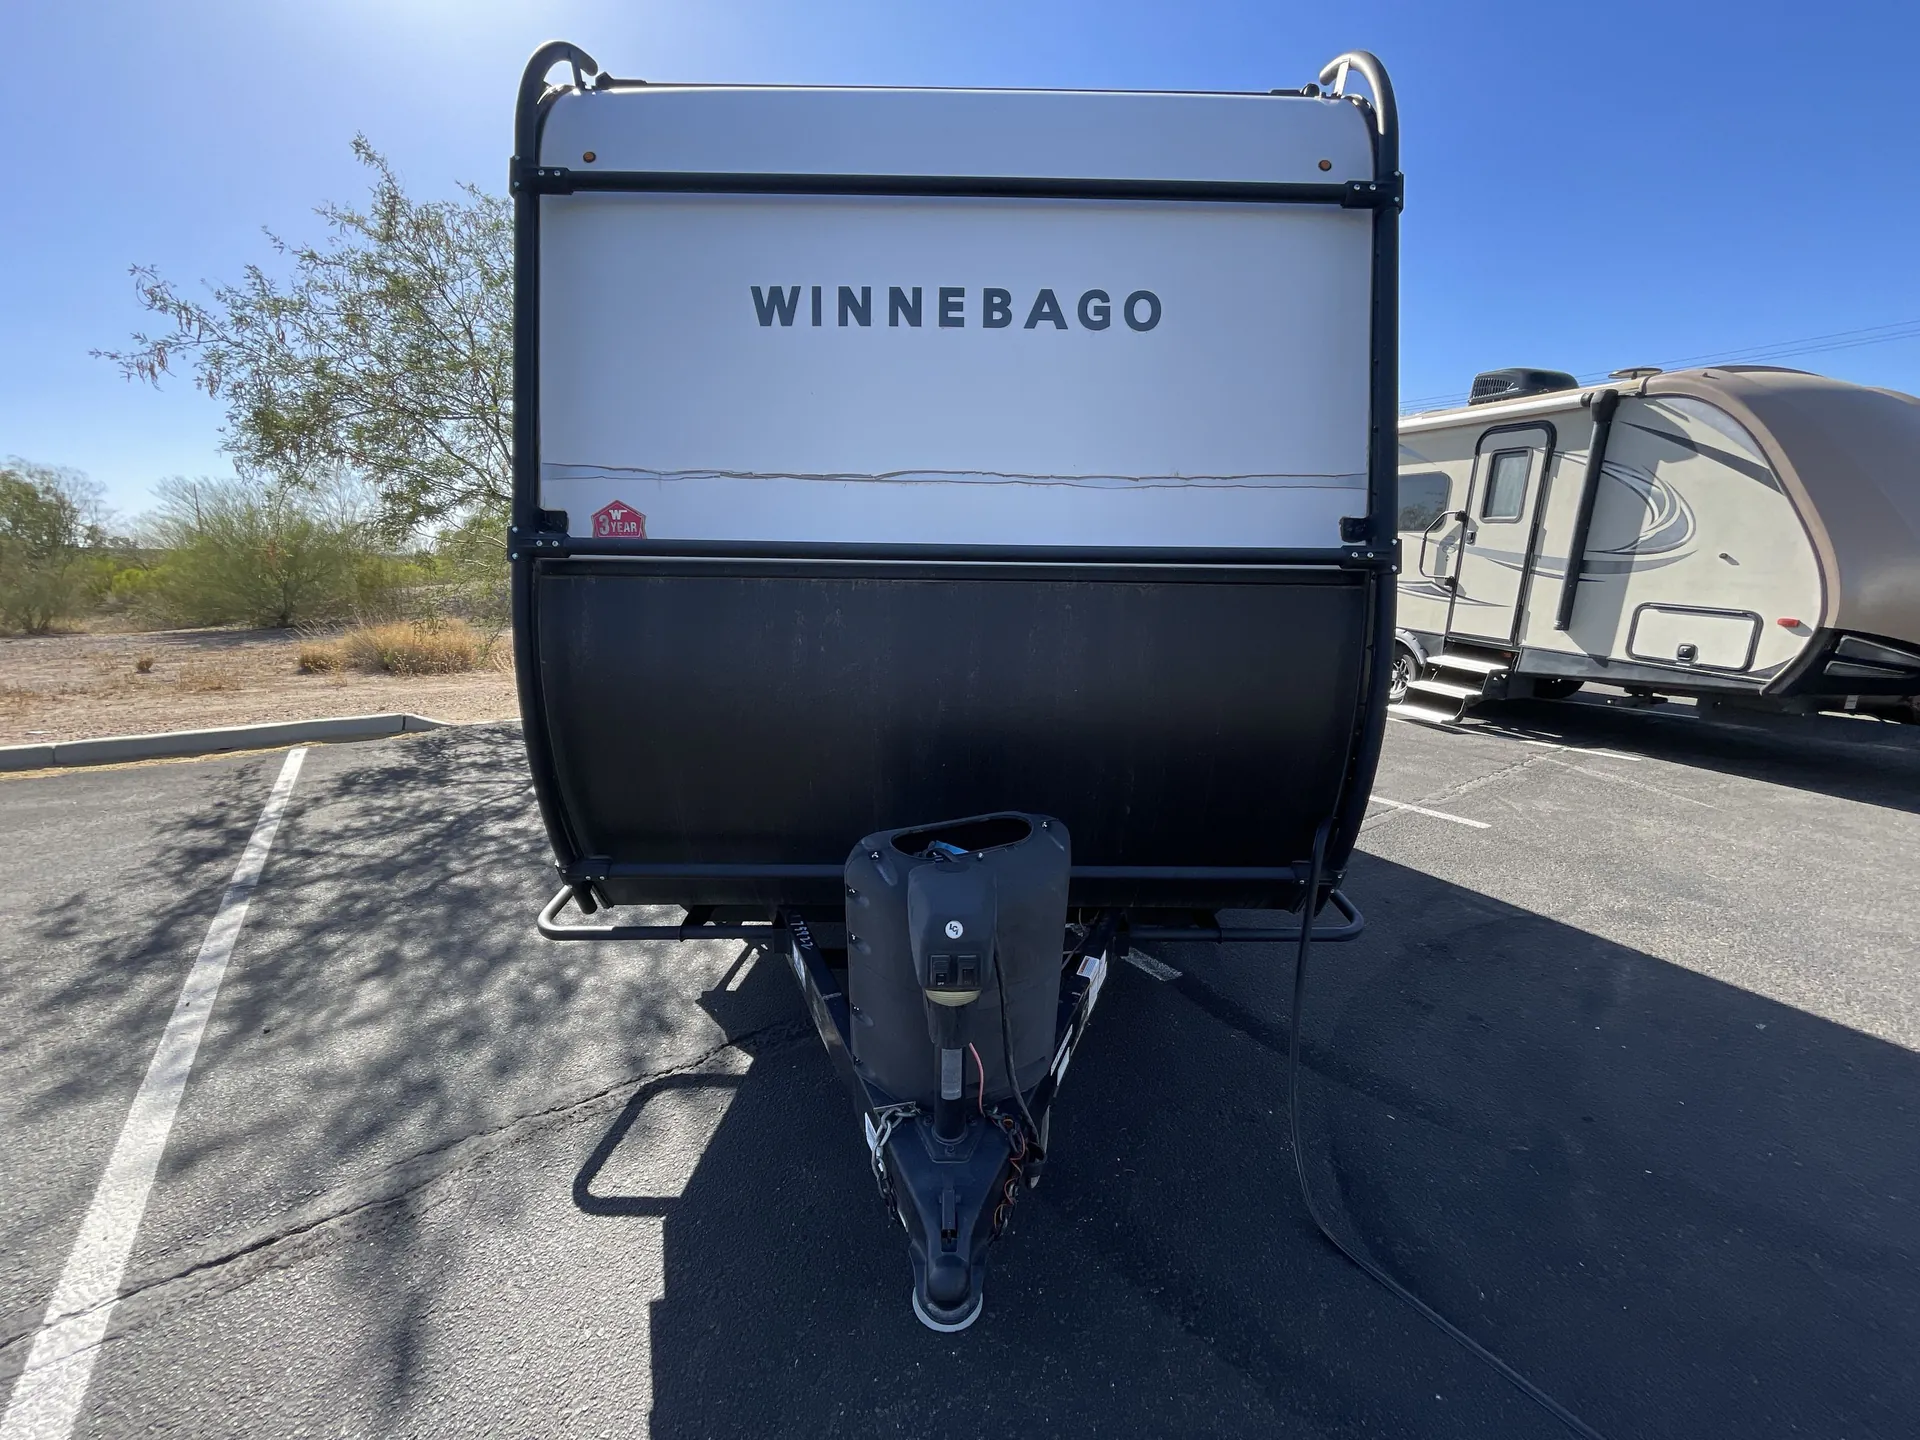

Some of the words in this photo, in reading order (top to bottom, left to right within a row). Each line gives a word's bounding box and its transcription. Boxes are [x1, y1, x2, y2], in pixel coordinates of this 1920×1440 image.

[750, 285, 1162, 332] WINNEBAGO
[599, 515, 609, 535] 3
[611, 521, 637, 533] YEAR
